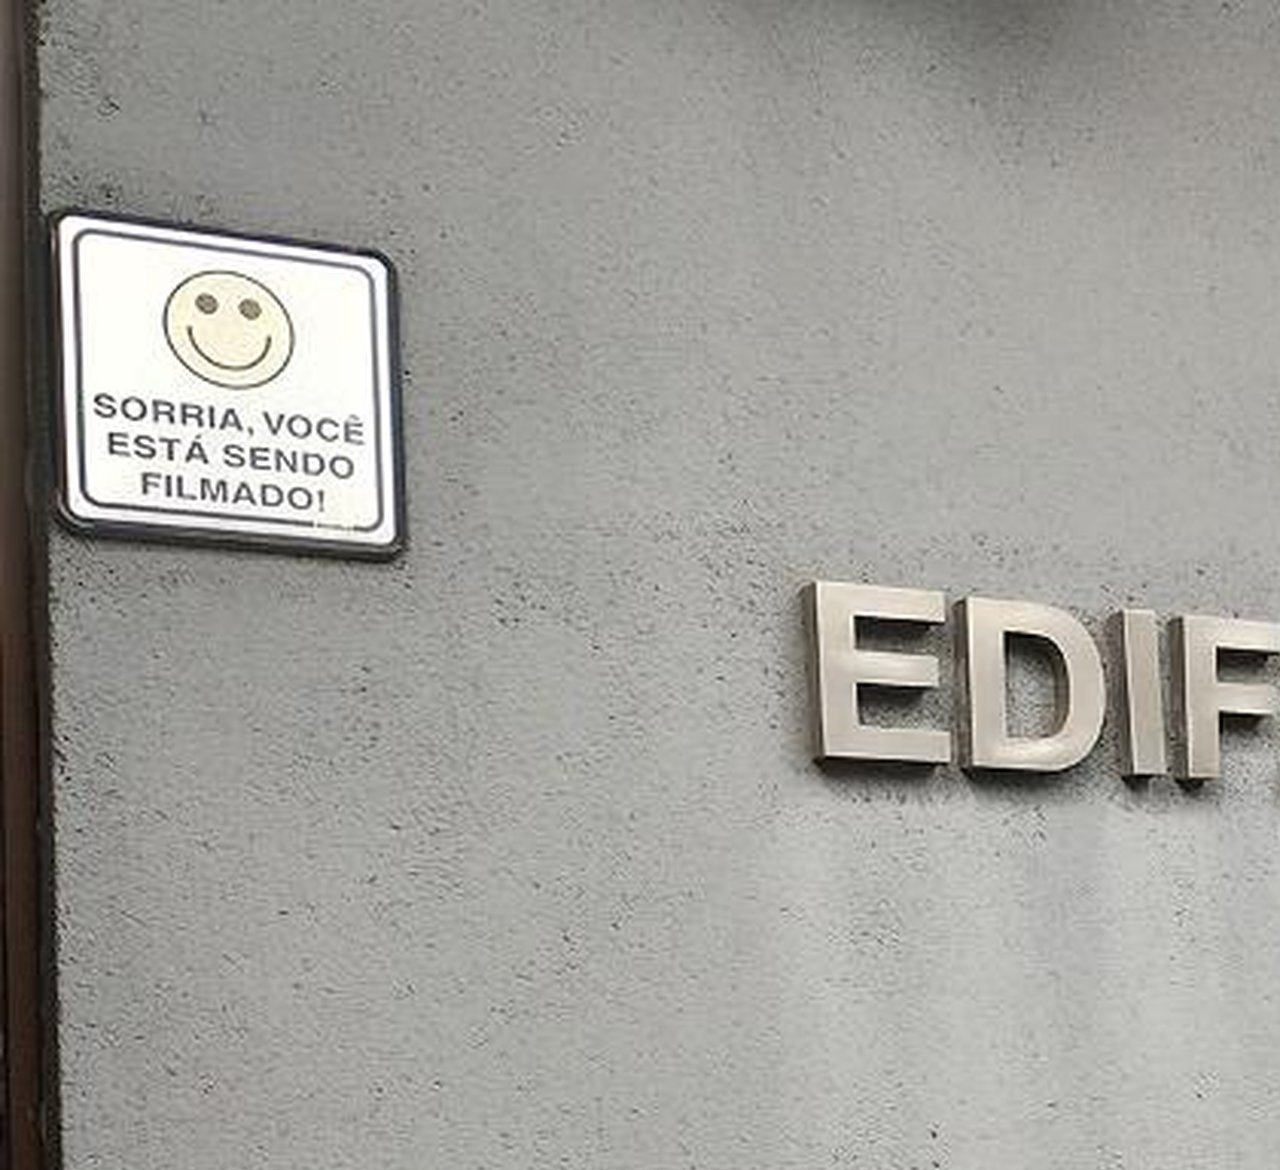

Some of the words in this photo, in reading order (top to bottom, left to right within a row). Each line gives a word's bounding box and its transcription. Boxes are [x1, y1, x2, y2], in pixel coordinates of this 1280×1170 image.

[93, 393, 255, 437] SORRIA,
[262, 411, 365, 446] VOCÊ
[107, 432, 210, 465] ESTÁ
[222, 443, 355, 480] SENDO
[141, 471, 327, 513] FILMADO!
